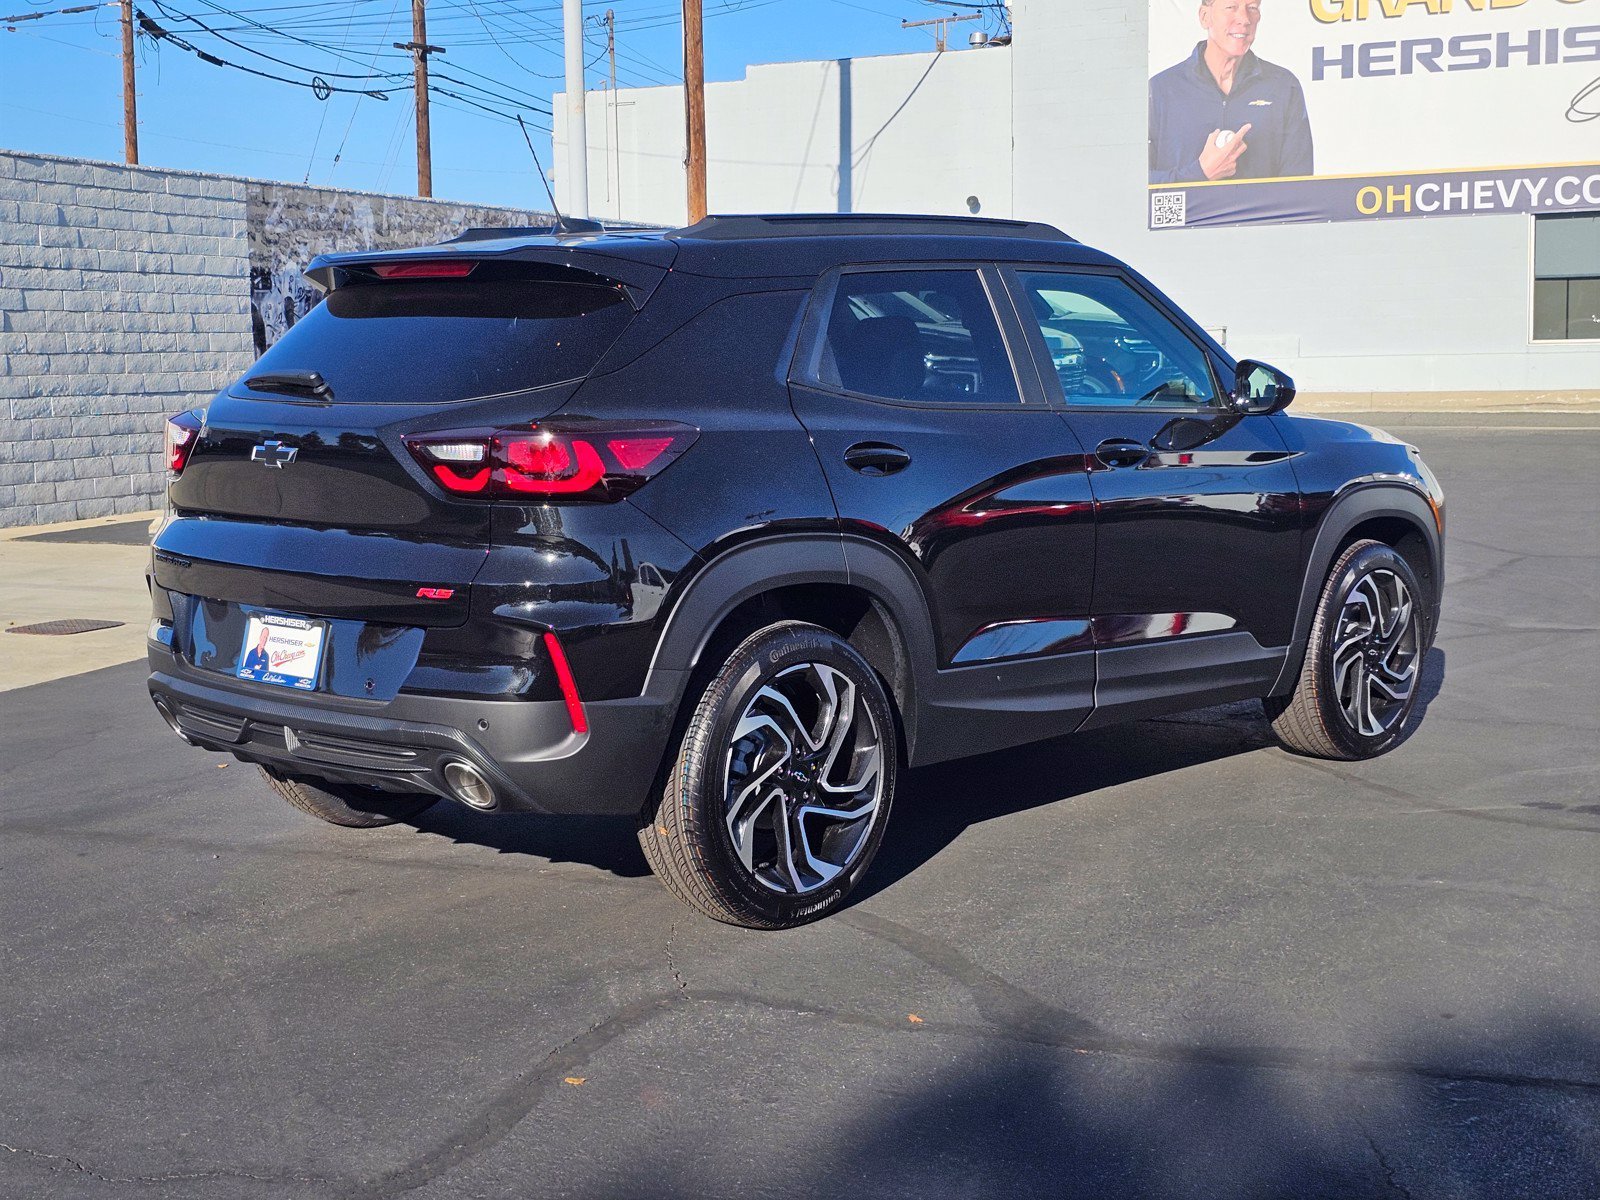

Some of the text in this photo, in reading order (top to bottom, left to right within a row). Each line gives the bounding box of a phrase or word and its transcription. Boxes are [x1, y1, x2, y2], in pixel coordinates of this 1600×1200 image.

[416, 587, 454, 599] RS
[264, 615, 306, 628] HERSHISER
[268, 636, 304, 647] HERSHISER
[796, 889, 842, 918] Continental
